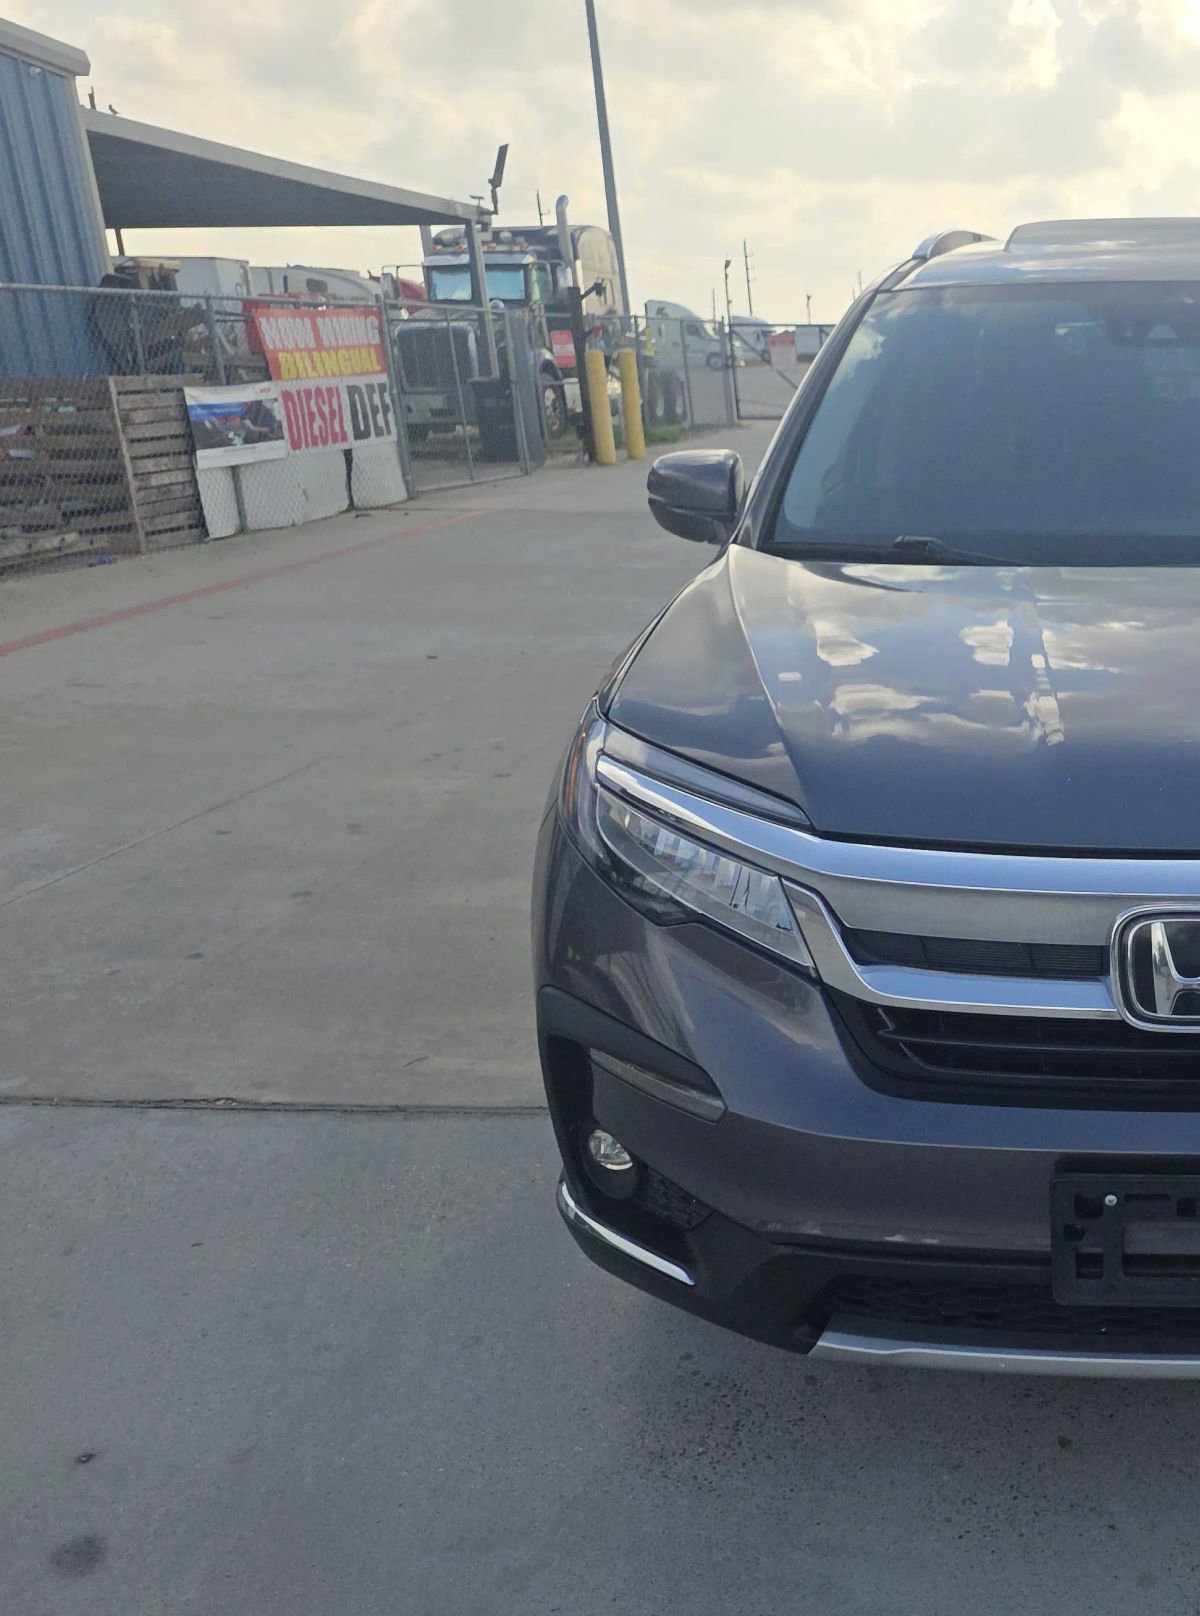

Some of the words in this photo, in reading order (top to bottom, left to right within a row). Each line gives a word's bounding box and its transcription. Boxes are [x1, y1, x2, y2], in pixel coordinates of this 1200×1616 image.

[278, 345, 382, 379] BILINGUAL
[281, 386, 349, 451] DIESEL
[346, 382, 393, 440] DEF
